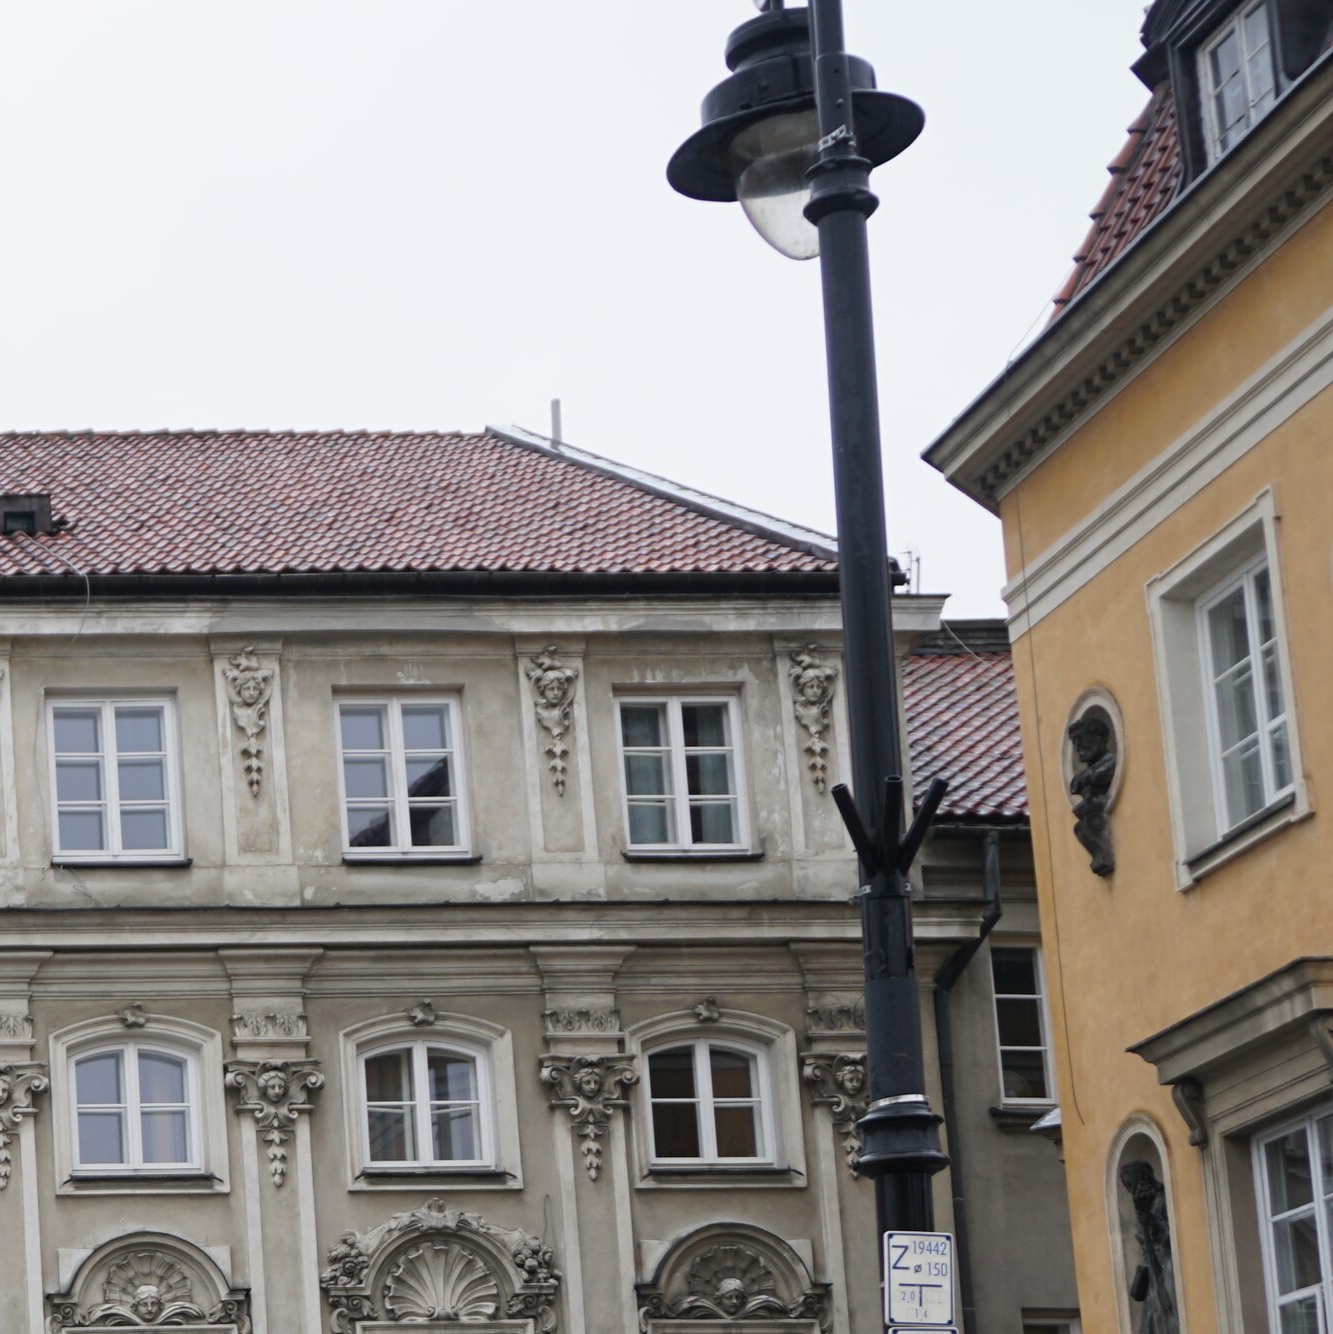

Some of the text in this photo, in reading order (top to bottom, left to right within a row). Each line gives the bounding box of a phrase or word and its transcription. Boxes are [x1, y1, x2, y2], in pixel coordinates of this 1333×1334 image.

[912, 1241, 947, 1256] 19442
[891, 1245, 910, 1270] Z
[927, 1262, 948, 1277] 150
